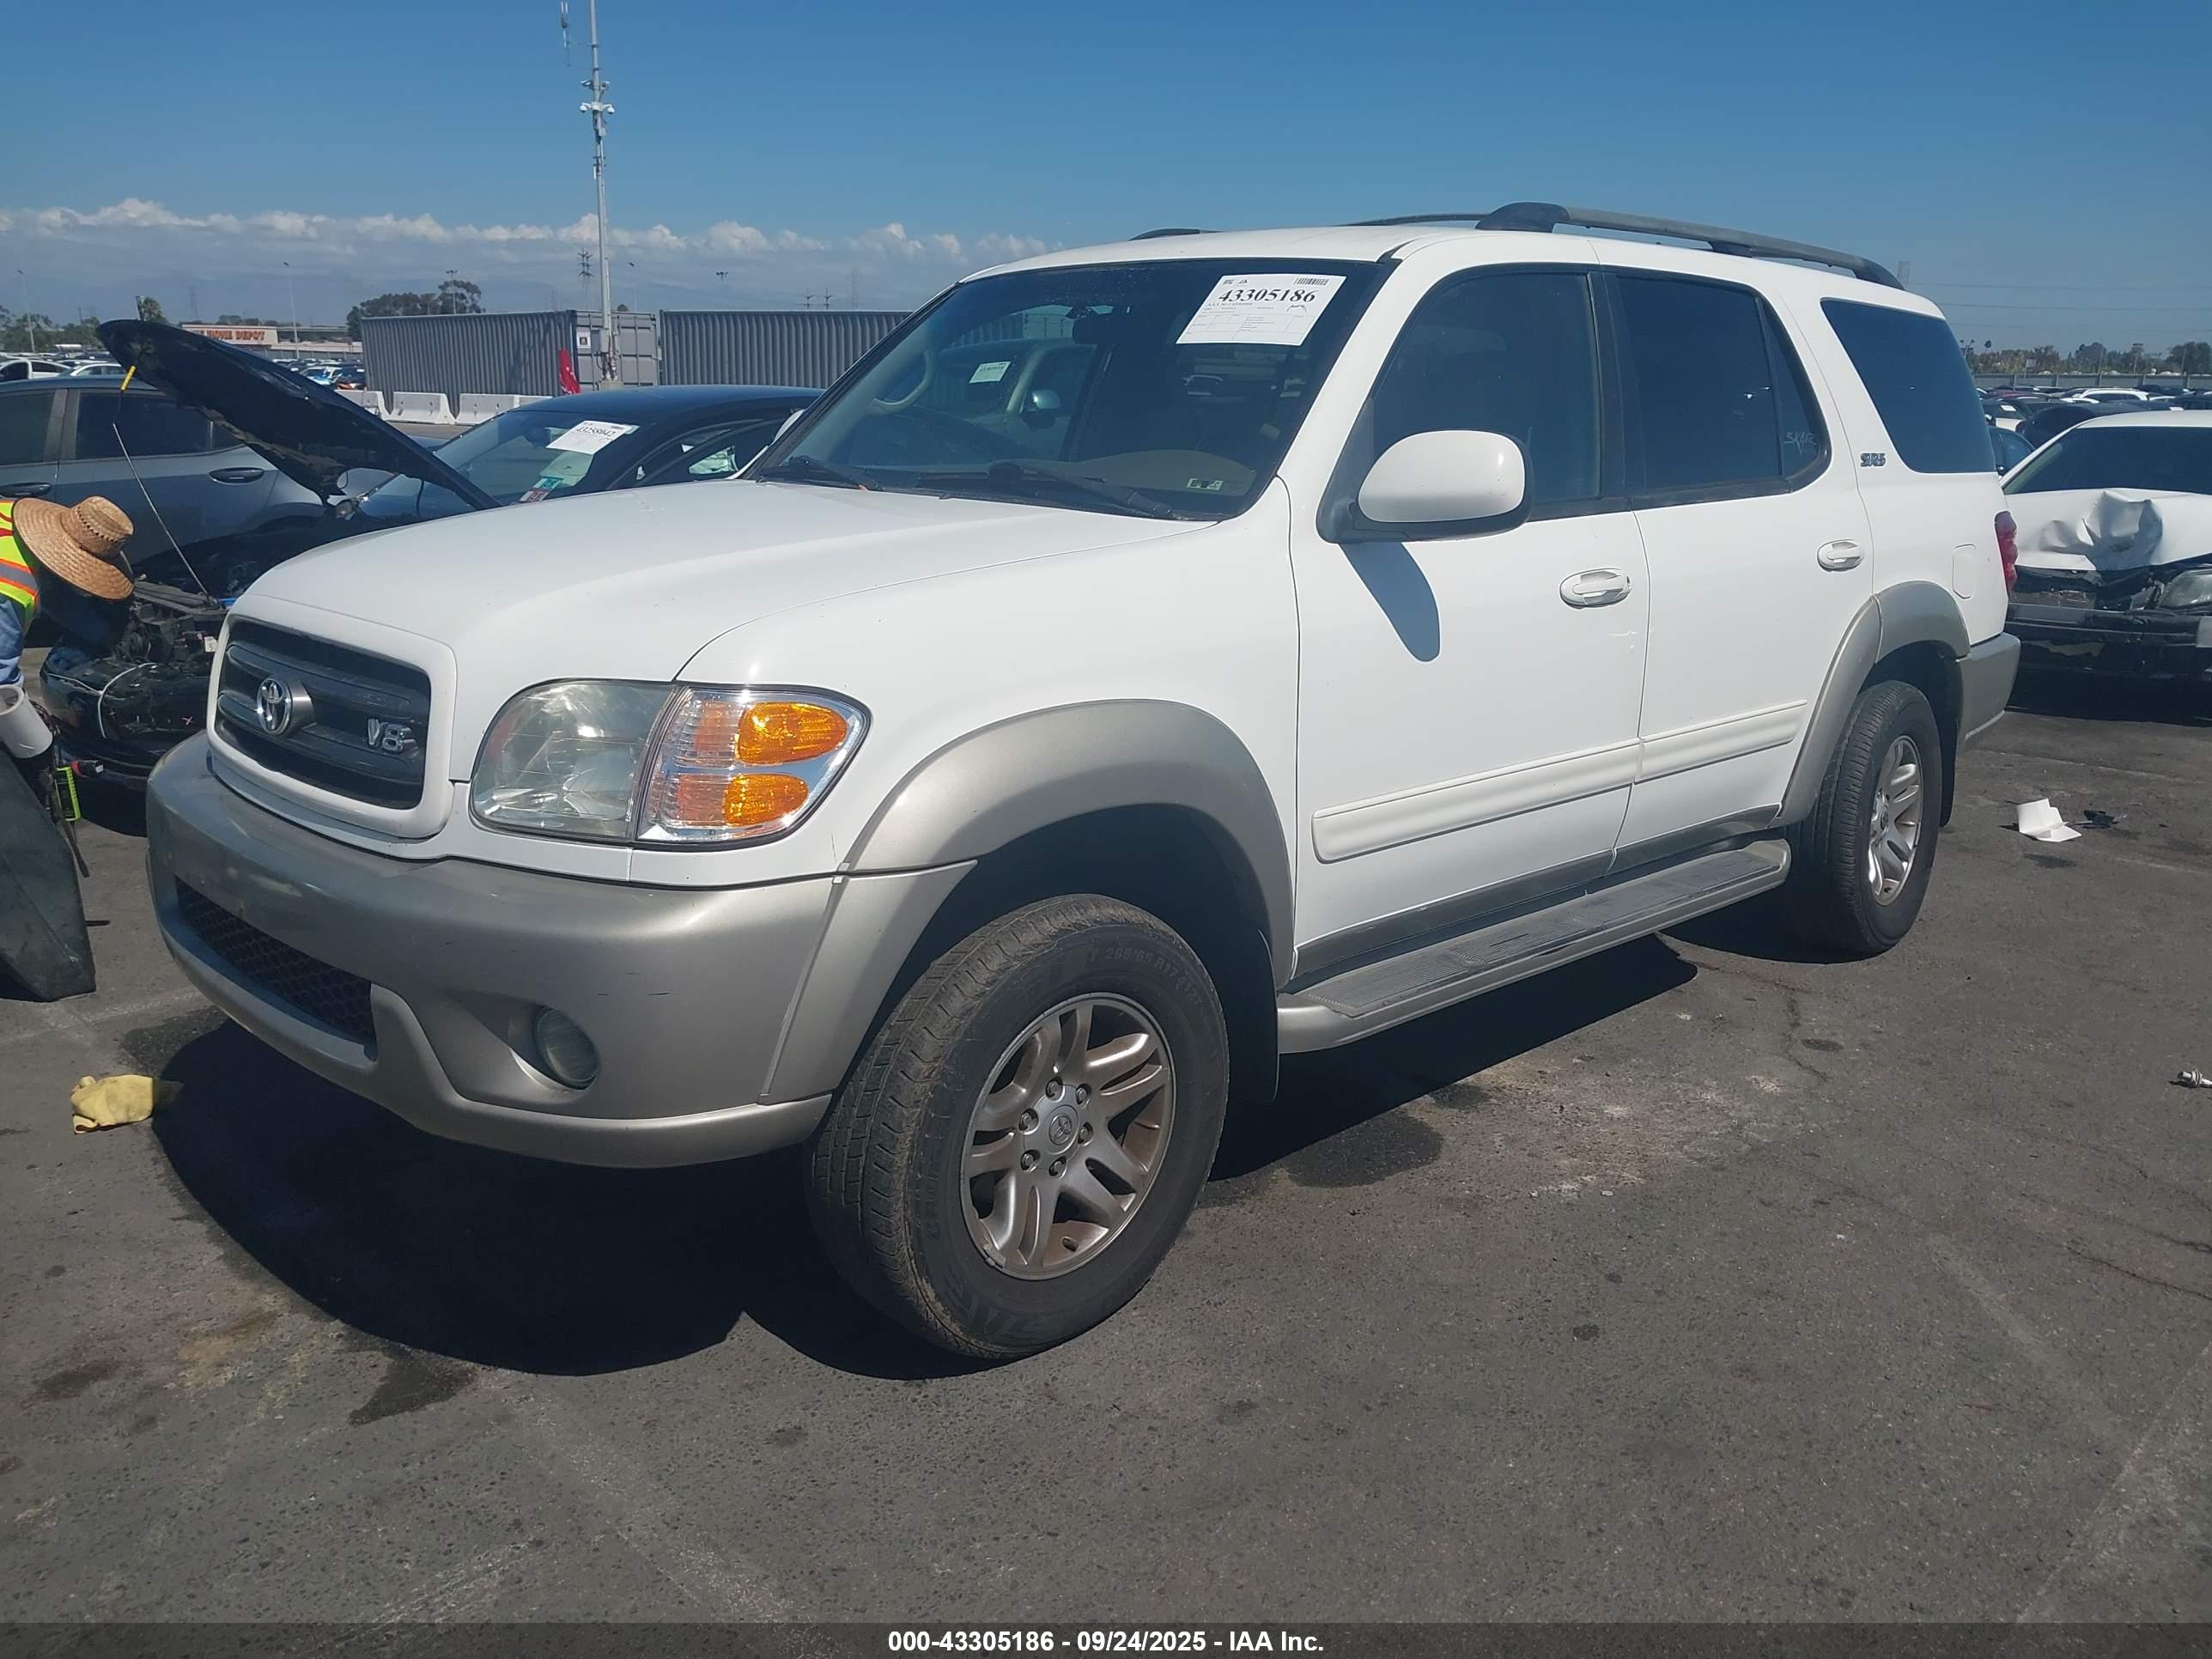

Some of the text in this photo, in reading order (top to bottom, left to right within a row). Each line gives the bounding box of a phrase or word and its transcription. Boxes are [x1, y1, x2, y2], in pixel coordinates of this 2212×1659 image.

[1218, 289, 1320, 303] 43305186
[235, 330, 265, 341] DEPOT
[1860, 453, 1887, 467] SR5
